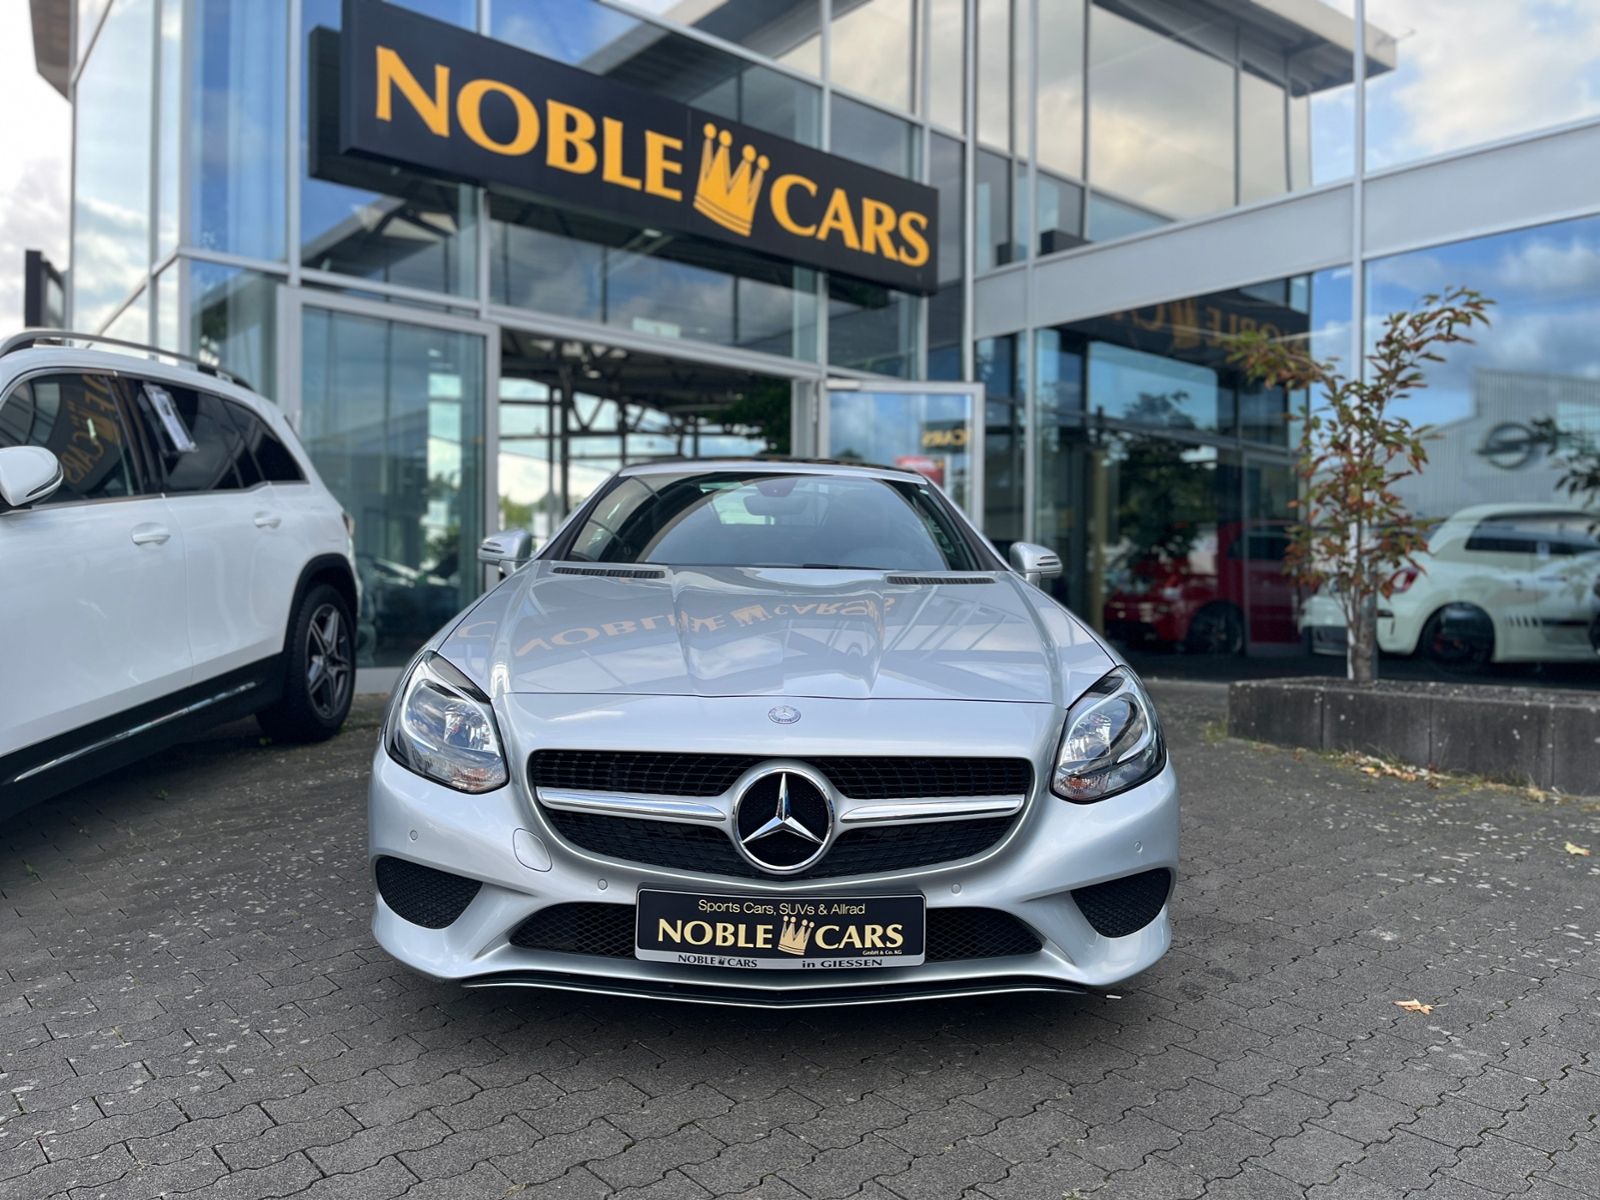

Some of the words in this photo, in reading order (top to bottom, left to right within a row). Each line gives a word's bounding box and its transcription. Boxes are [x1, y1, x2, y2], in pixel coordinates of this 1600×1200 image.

[375, 45, 683, 201] NOBLE
[769, 173, 929, 267] CARS
[698, 899, 740, 913] Sports
[743, 901, 777, 915] Cars,
[779, 902, 815, 915] SUVs
[818, 903, 828, 915] &
[830, 903, 865, 915] Allrad
[658, 918, 774, 949] NOBLE
[815, 923, 903, 949] CARS
[678, 954, 716, 966] NOBLE
[727, 958, 758, 968] CARS
[802, 960, 816, 968] in
[820, 959, 883, 968] GIESSEN
